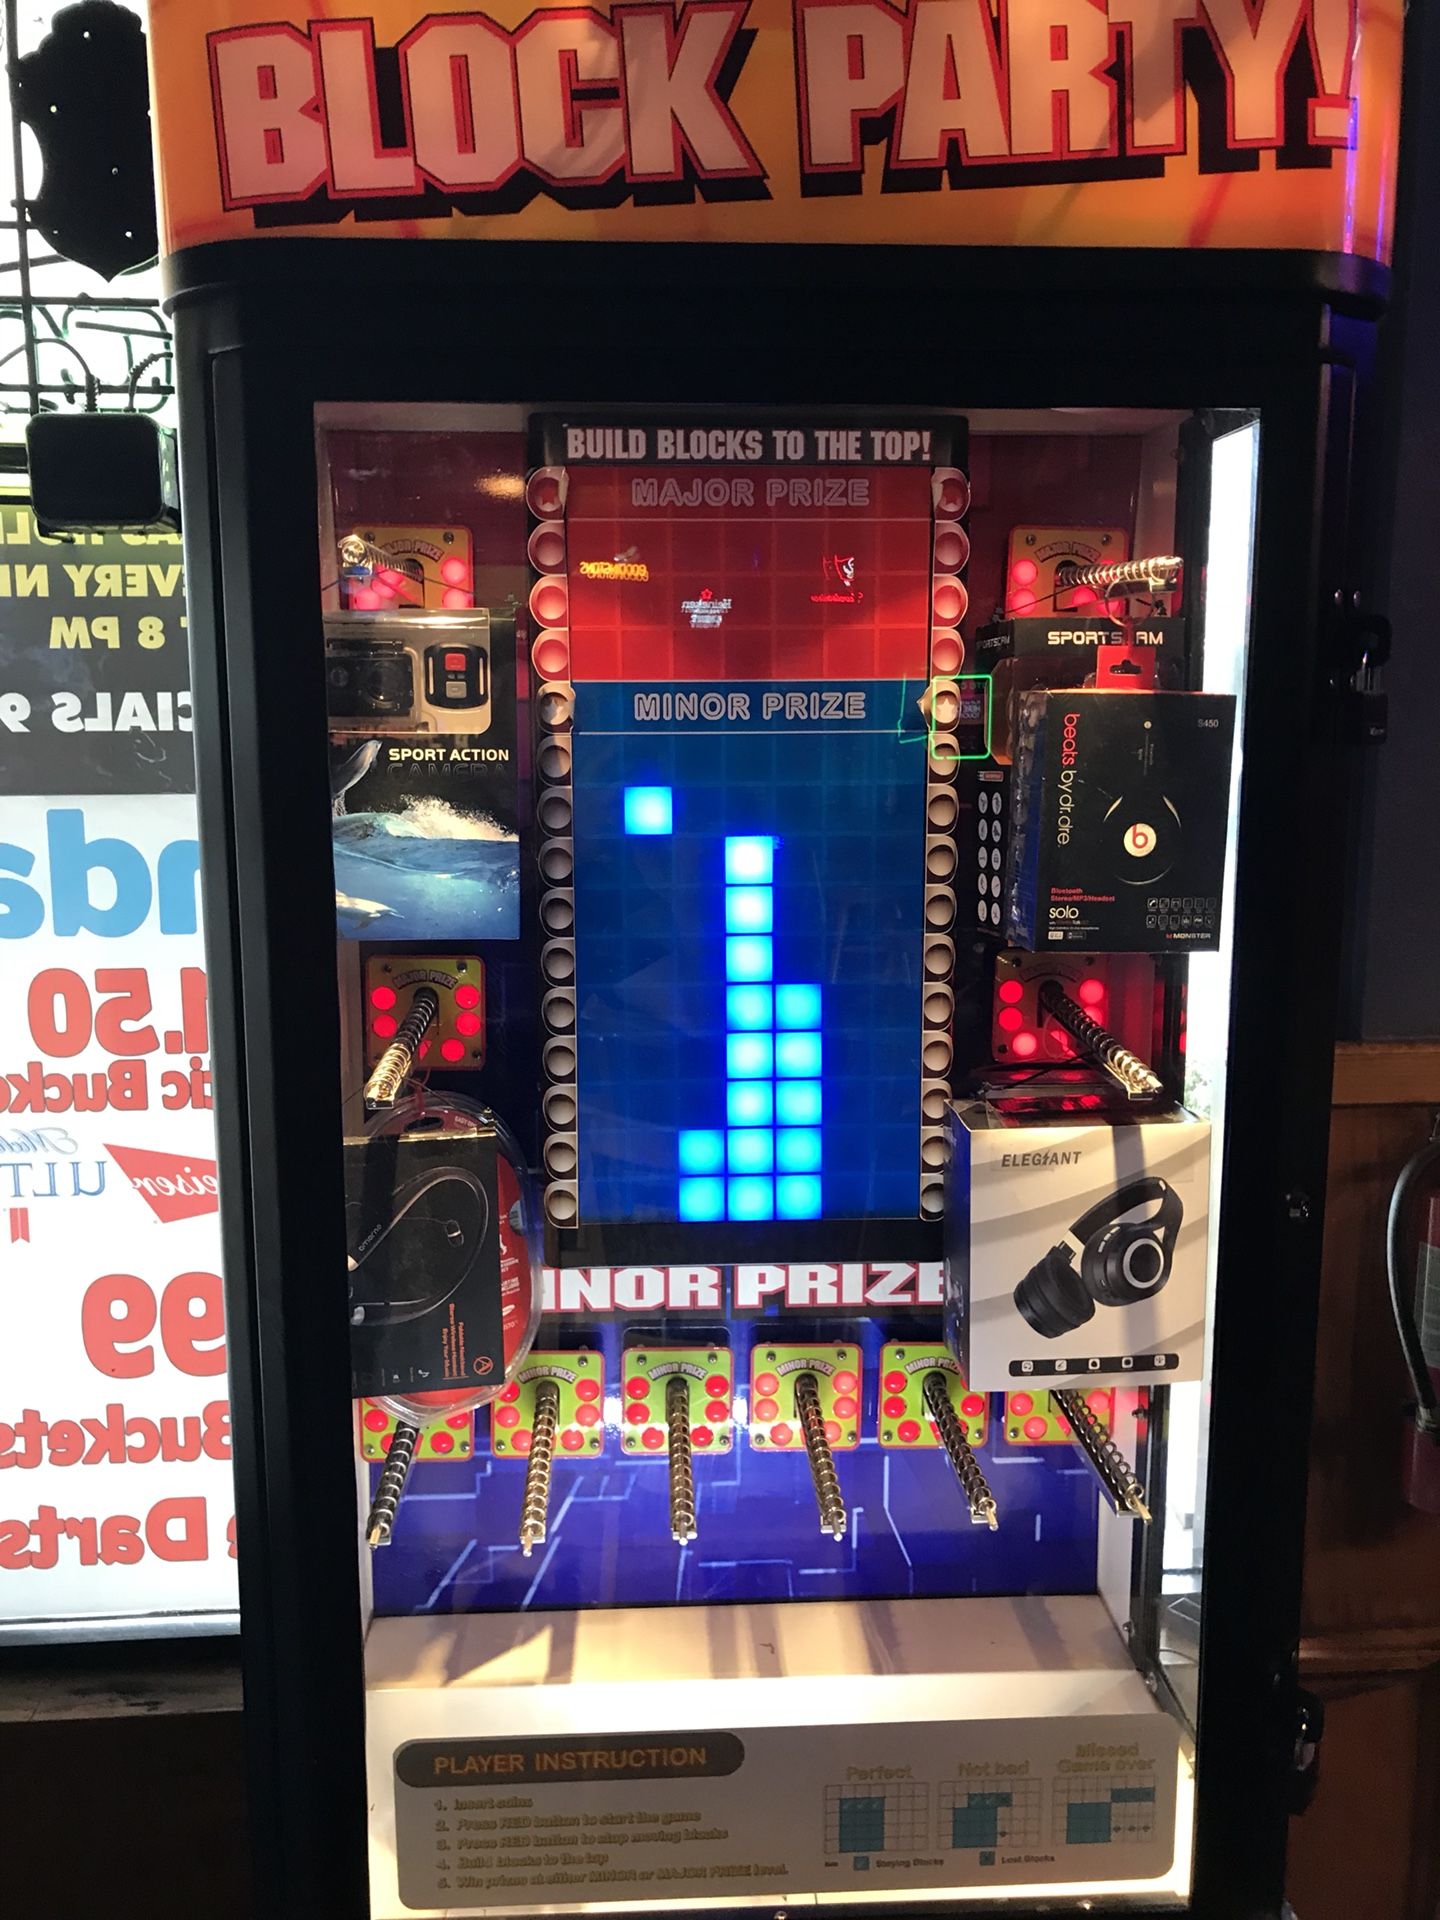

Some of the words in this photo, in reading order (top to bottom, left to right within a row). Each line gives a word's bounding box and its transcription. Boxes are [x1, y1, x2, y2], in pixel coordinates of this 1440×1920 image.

[206, 0, 767, 212] BLOCK
[794, 0, 1358, 174] PARTY!
[567, 428, 646, 460] BUILD
[656, 428, 763, 461] BLOCKS
[772, 429, 806, 460] TO
[815, 429, 862, 461] THE
[870, 429, 932, 461] TOP!
[631, 478, 755, 507] MAJOR
[766, 478, 870, 506] PRIZE
[414, 539, 445, 563] PRIZE
[1047, 630, 1164, 646] SPORTSAM
[634, 693, 751, 721] MINOR
[762, 692, 867, 720] PRIZE
[1197, 718, 1220, 728] S450
[1061, 713, 1081, 766] beats
[388, 748, 447, 761] SPORT
[449, 748, 510, 761] ACTION
[1057, 769, 1078, 793] by
[1048, 904, 1079, 920] solo
[1173, 932, 1212, 940] MONSTER
[392, 969, 428, 990] MAJOR
[429, 969, 459, 990] PRIZE
[518, 1365, 550, 1384] MINOR
[551, 1365, 579, 1384] PRIZE
[648, 1362, 679, 1381] MINOR
[680, 1361, 708, 1381] PRIZE
[776, 1357, 807, 1376] MINOR
[808, 1358, 836, 1376] PRIZE
[905, 1356, 937, 1375] MINOR
[938, 1356, 961, 1375] PRIZ
[433, 1753, 525, 1775] PLAYER
[534, 1746, 707, 1773] INSTRUCTION
[958, 1761, 991, 1777] Not
[847, 1764, 914, 1780] Perfect
